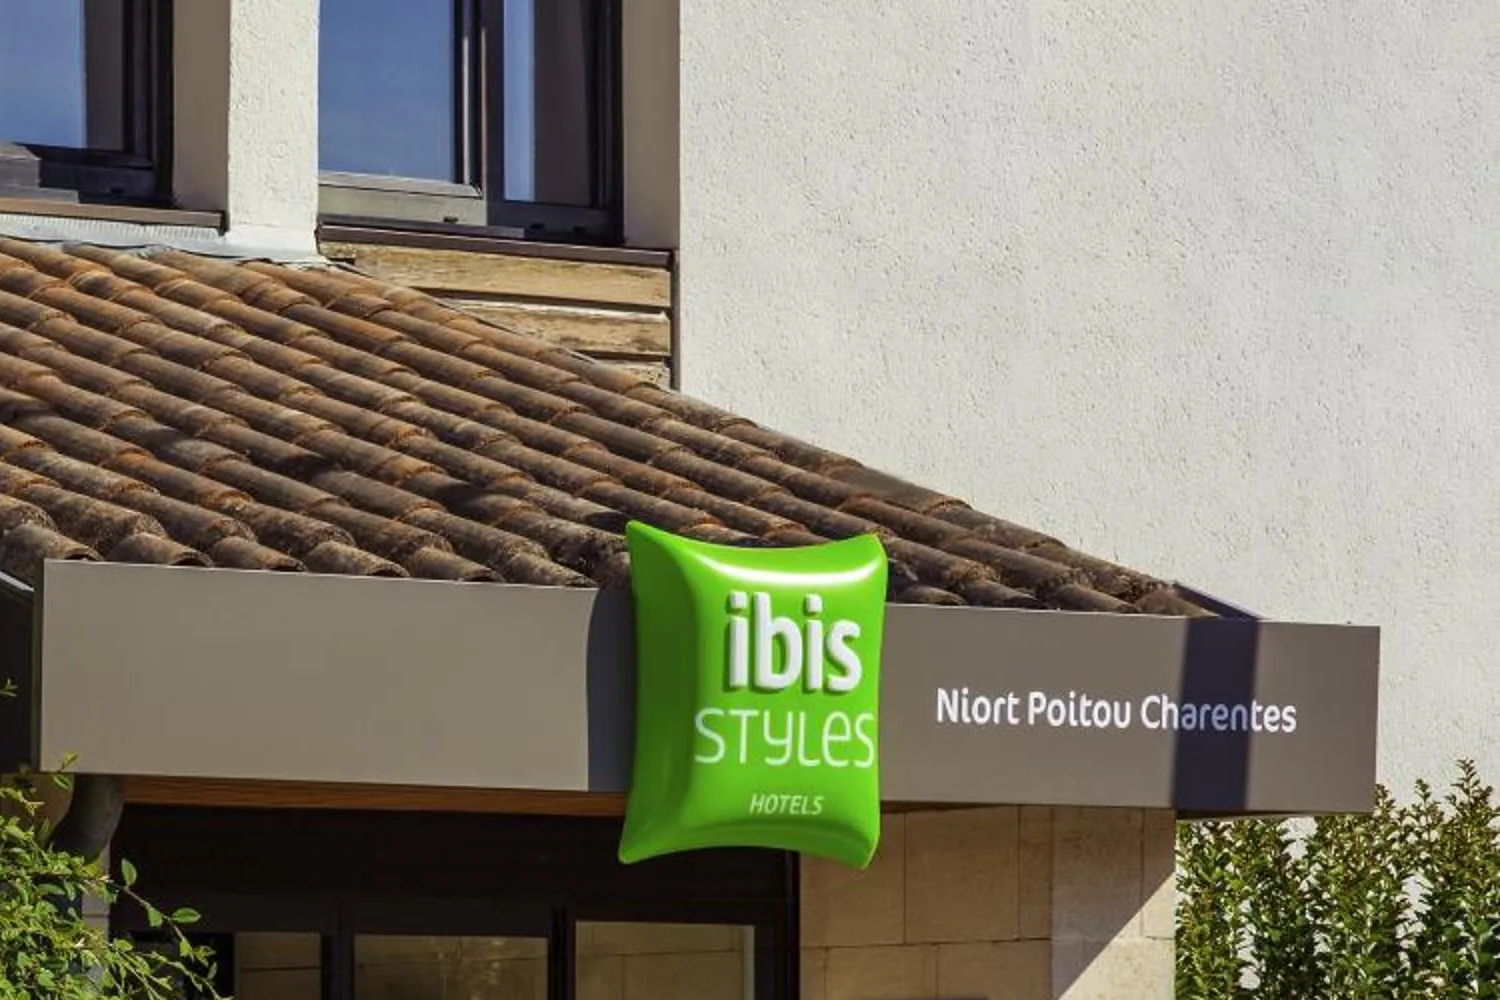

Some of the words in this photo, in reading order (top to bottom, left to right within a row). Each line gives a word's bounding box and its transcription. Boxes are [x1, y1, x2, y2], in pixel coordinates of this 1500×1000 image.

[729, 591, 862, 692] ibis
[936, 687, 1021, 726] Niort
[1027, 690, 1132, 729] Poitou
[1140, 693, 1297, 733] Charentes
[749, 794, 825, 816] HOTELS
